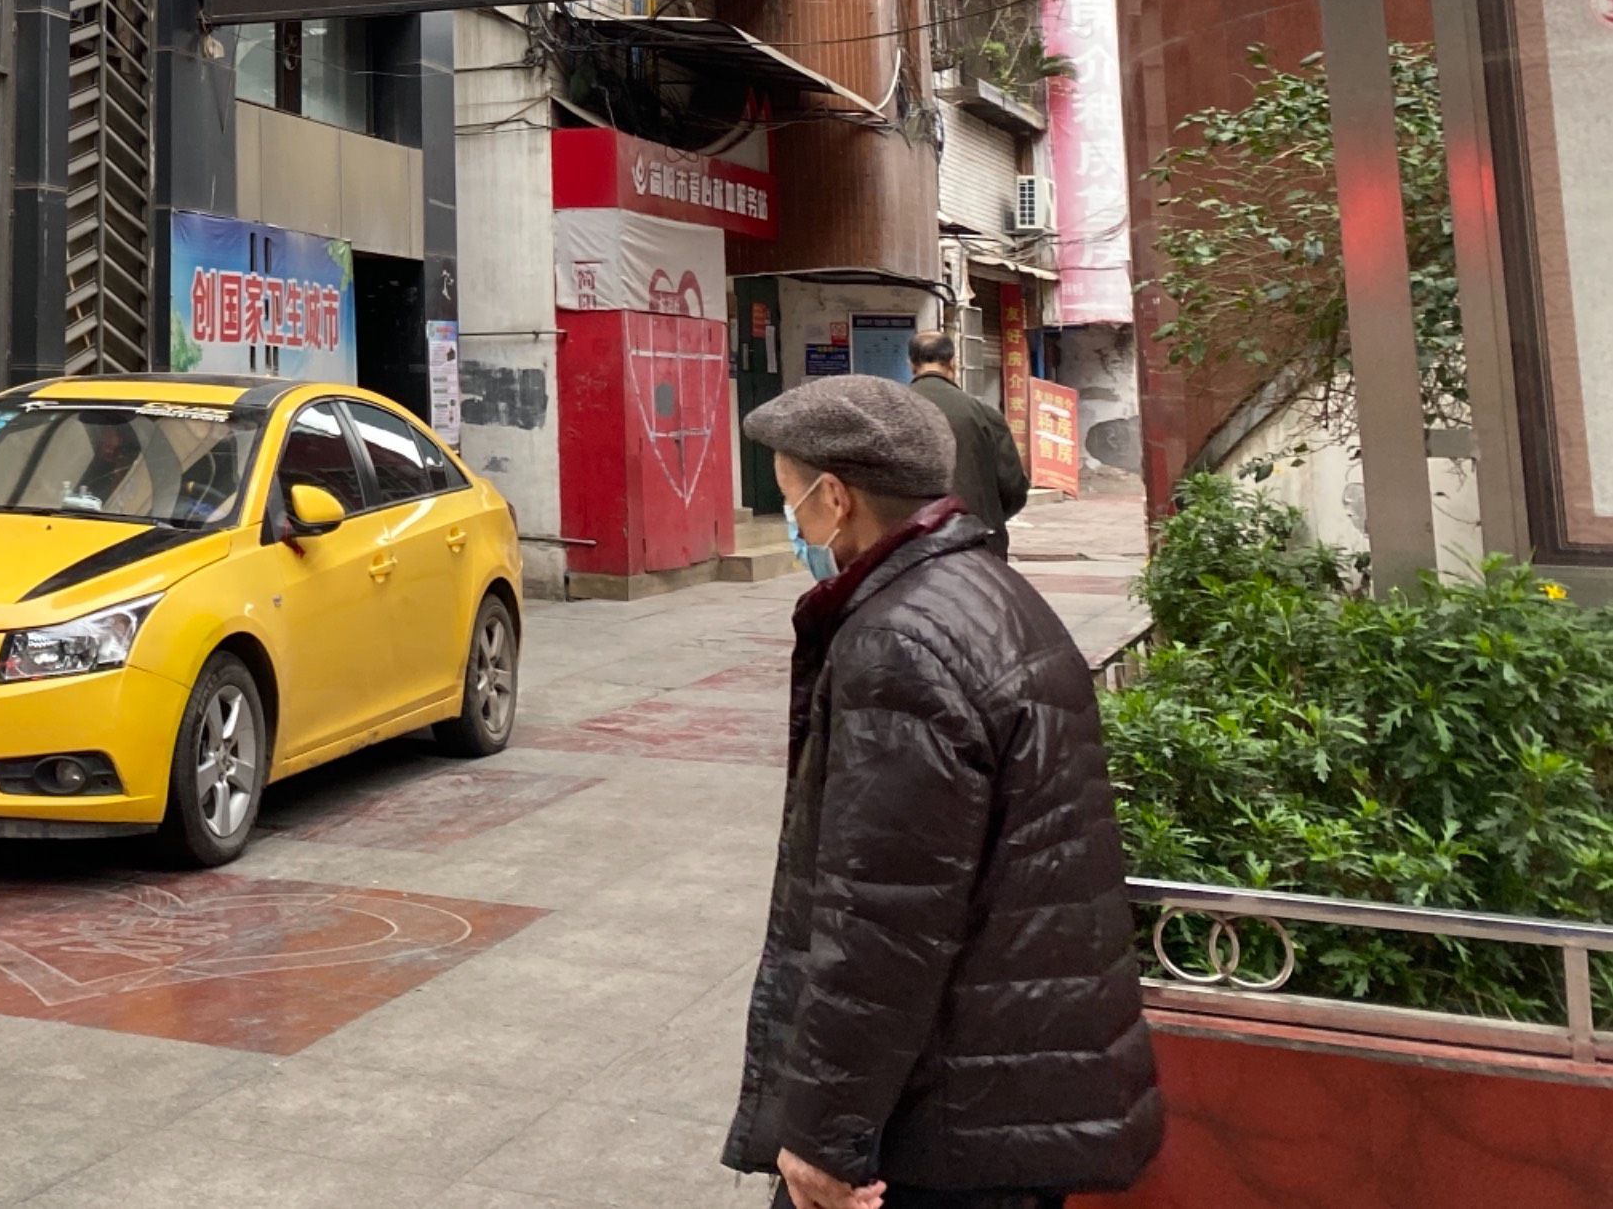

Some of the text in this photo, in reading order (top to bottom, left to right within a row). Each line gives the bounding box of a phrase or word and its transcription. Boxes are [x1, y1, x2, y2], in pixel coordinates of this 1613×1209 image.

[192, 267, 340, 352] 创国家卫生城市
